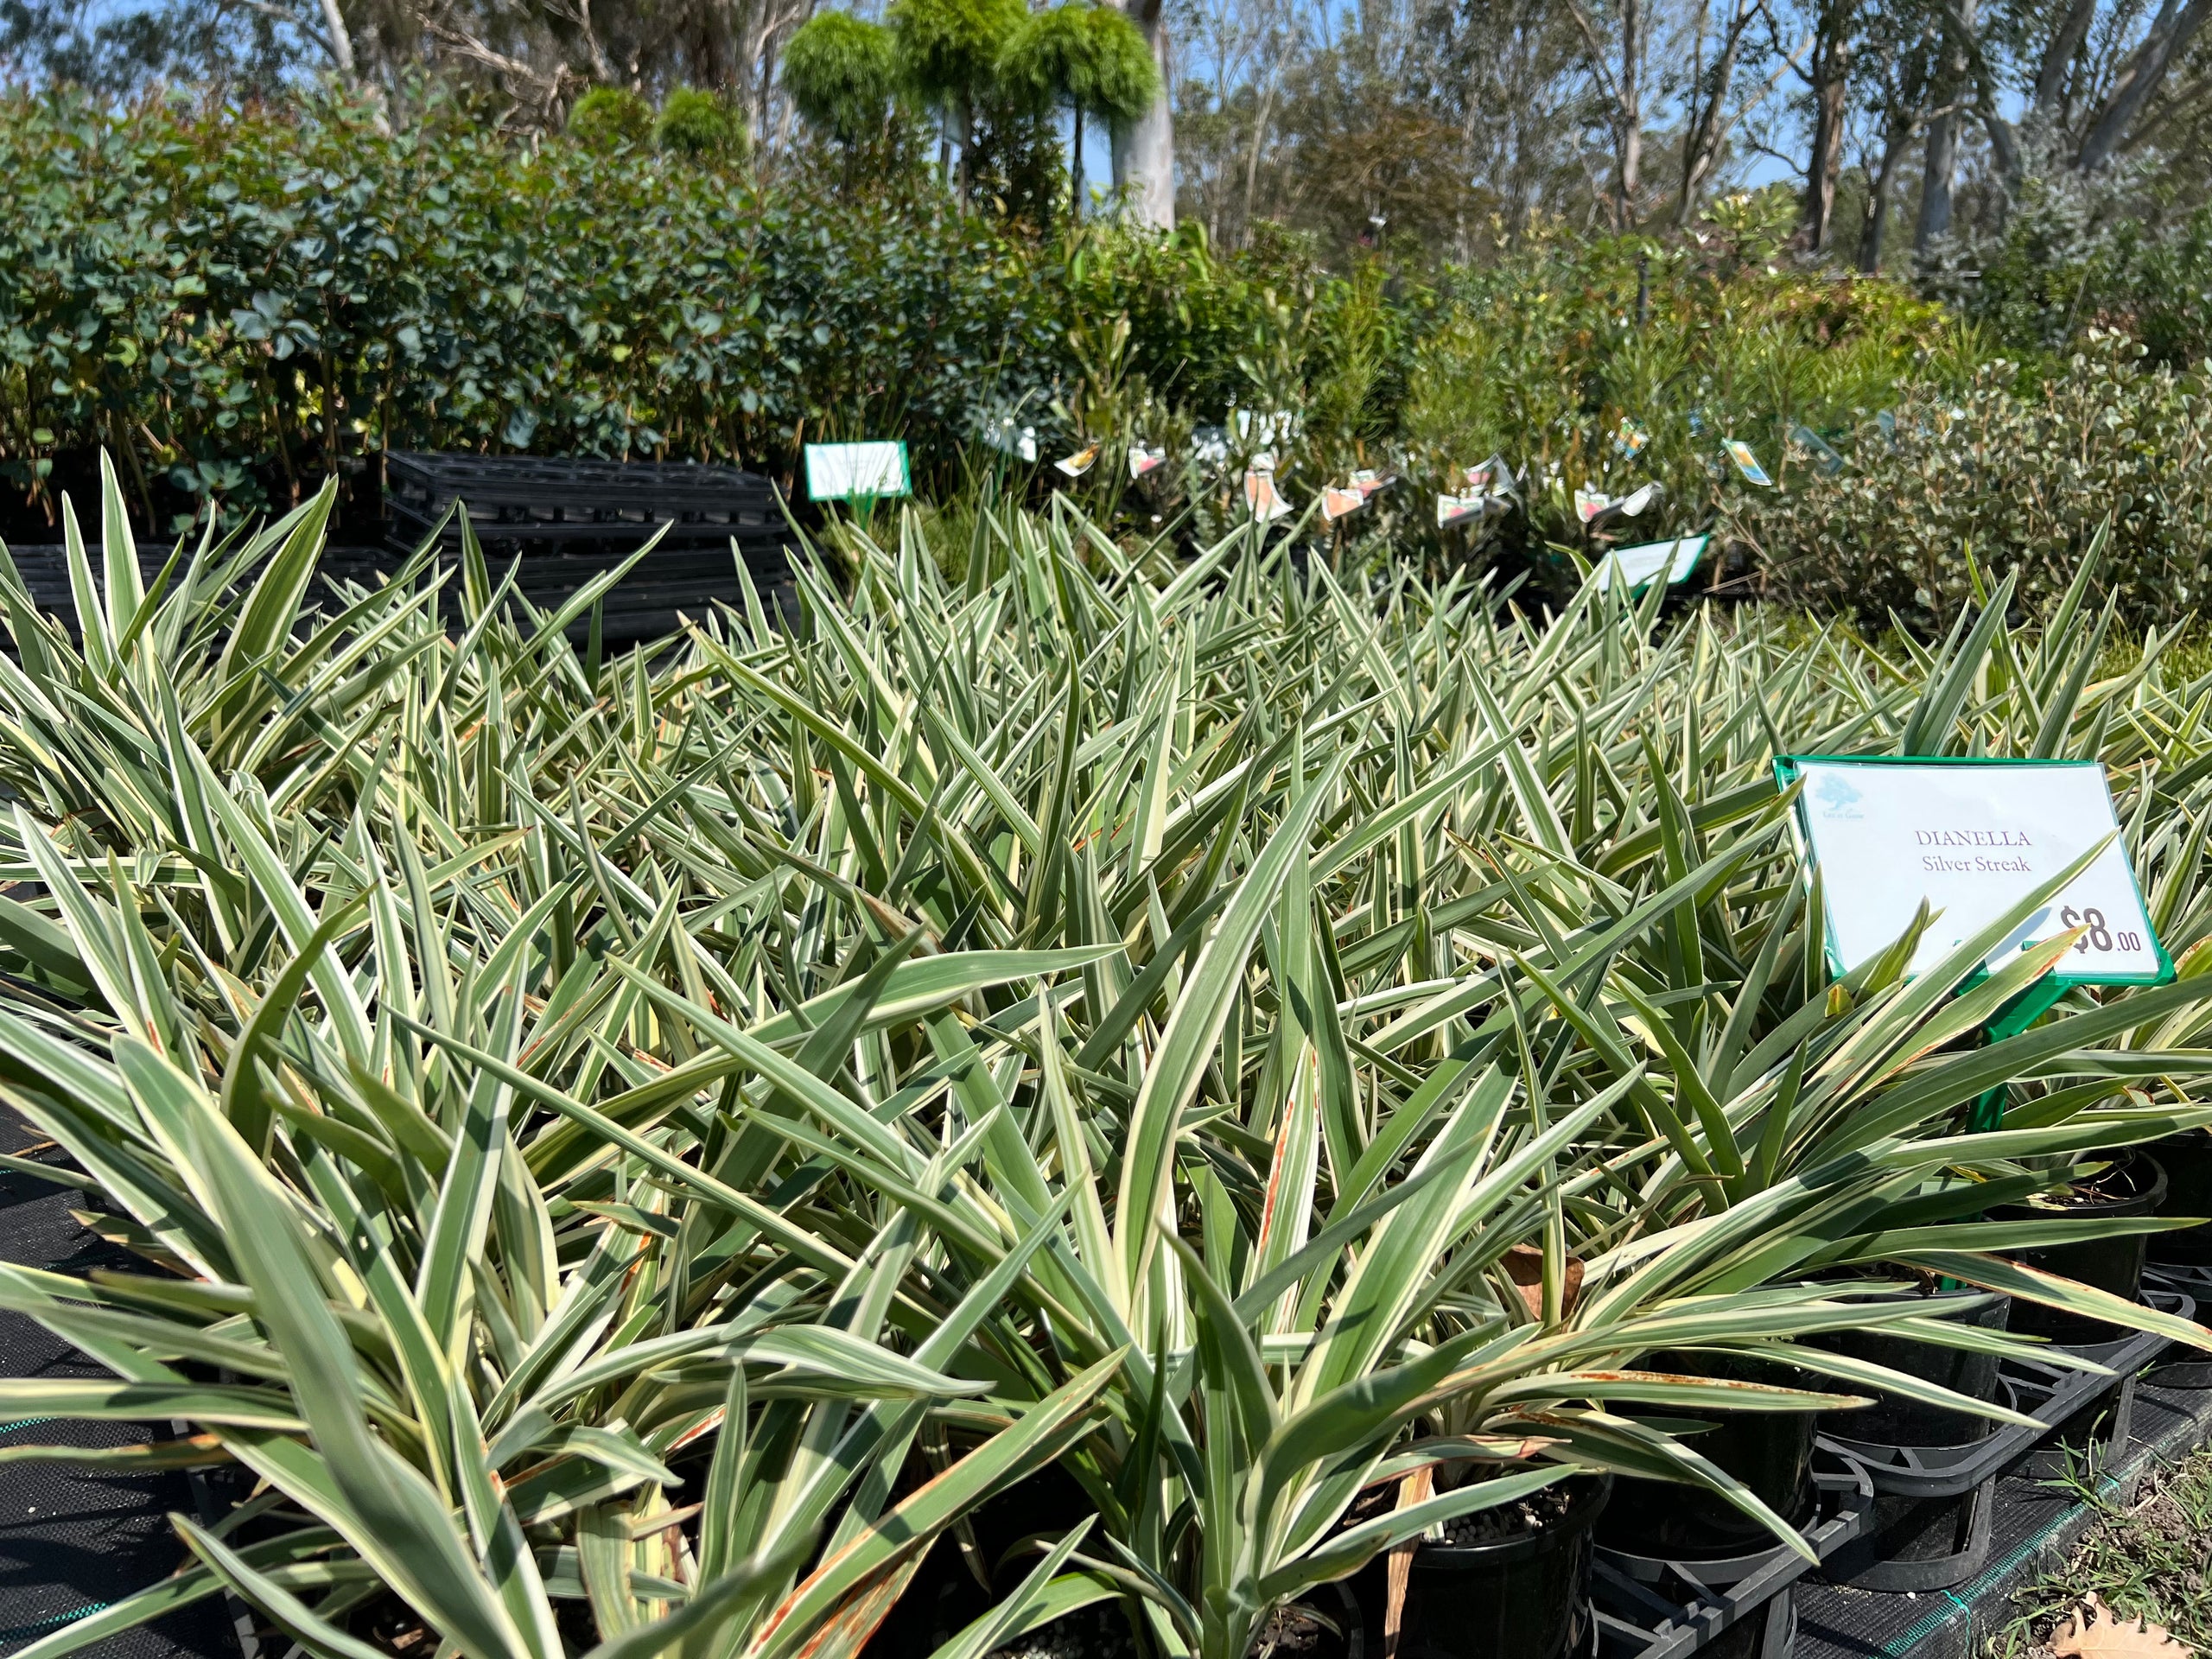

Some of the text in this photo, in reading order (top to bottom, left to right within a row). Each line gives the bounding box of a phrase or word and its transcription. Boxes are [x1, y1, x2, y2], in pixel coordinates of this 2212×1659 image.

[1914, 830, 2033, 847] DIANELLA
[1922, 855, 2033, 872] Silver Streak
